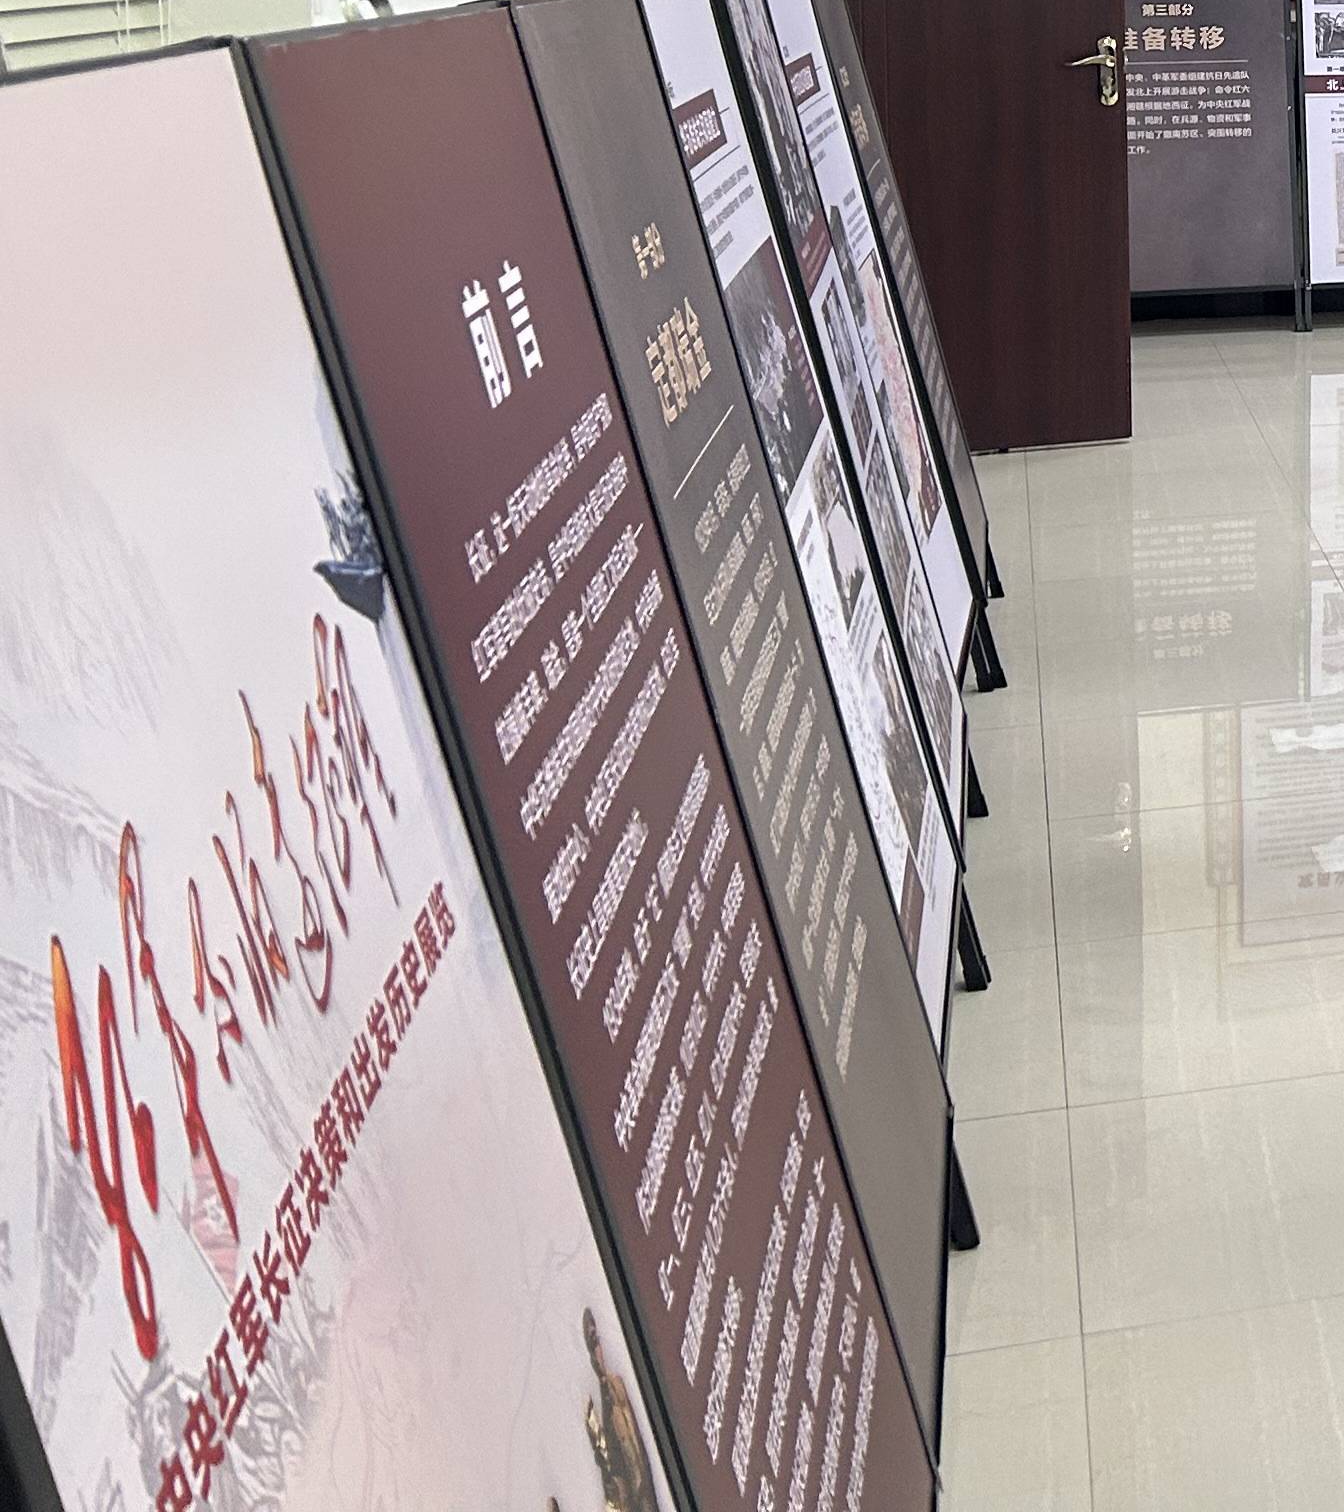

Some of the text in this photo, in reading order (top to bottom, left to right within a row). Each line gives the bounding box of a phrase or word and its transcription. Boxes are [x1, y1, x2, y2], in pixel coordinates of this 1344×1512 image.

[1142, 3, 1194, 17] 第三部分
[461, 259, 544, 409] 前言
[645, 296, 712, 430] 定都瑞金
